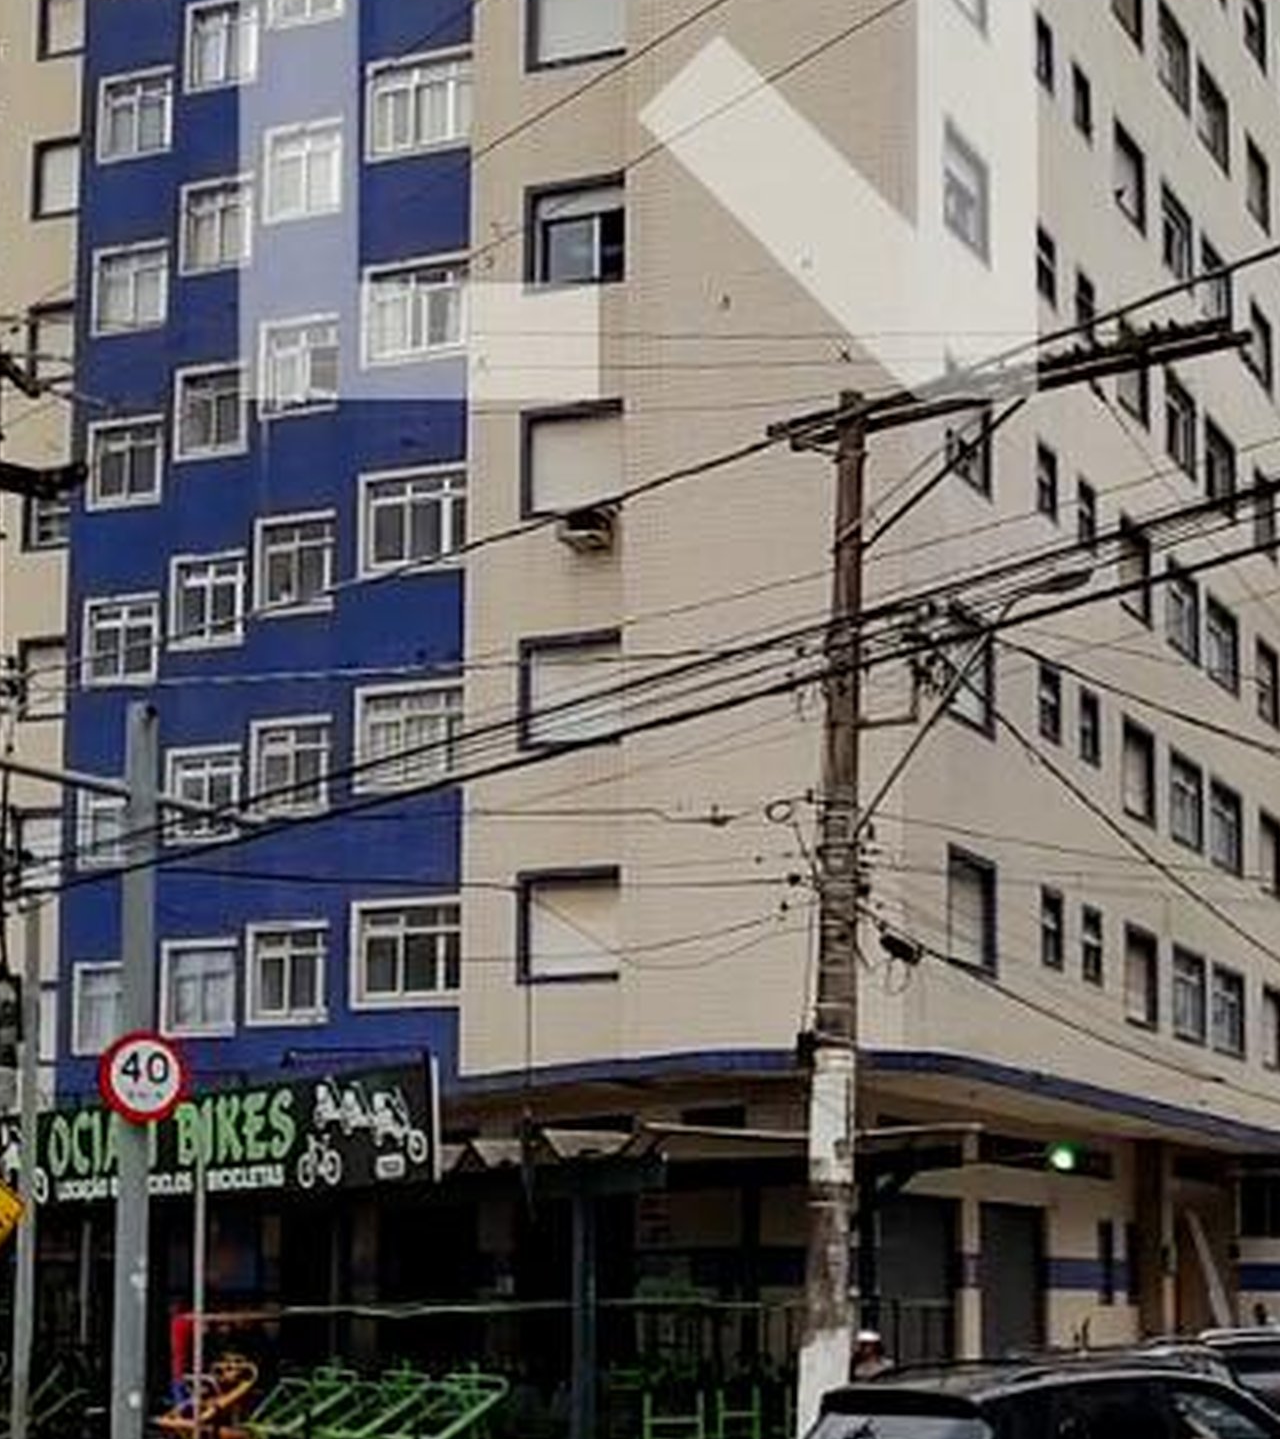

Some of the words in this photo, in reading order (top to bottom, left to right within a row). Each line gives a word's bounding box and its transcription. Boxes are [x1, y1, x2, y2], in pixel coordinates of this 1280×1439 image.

[121, 1051, 170, 1084] 40
[47, 1111, 158, 1177] OCIA
[175, 1088, 297, 1167] BIKES
